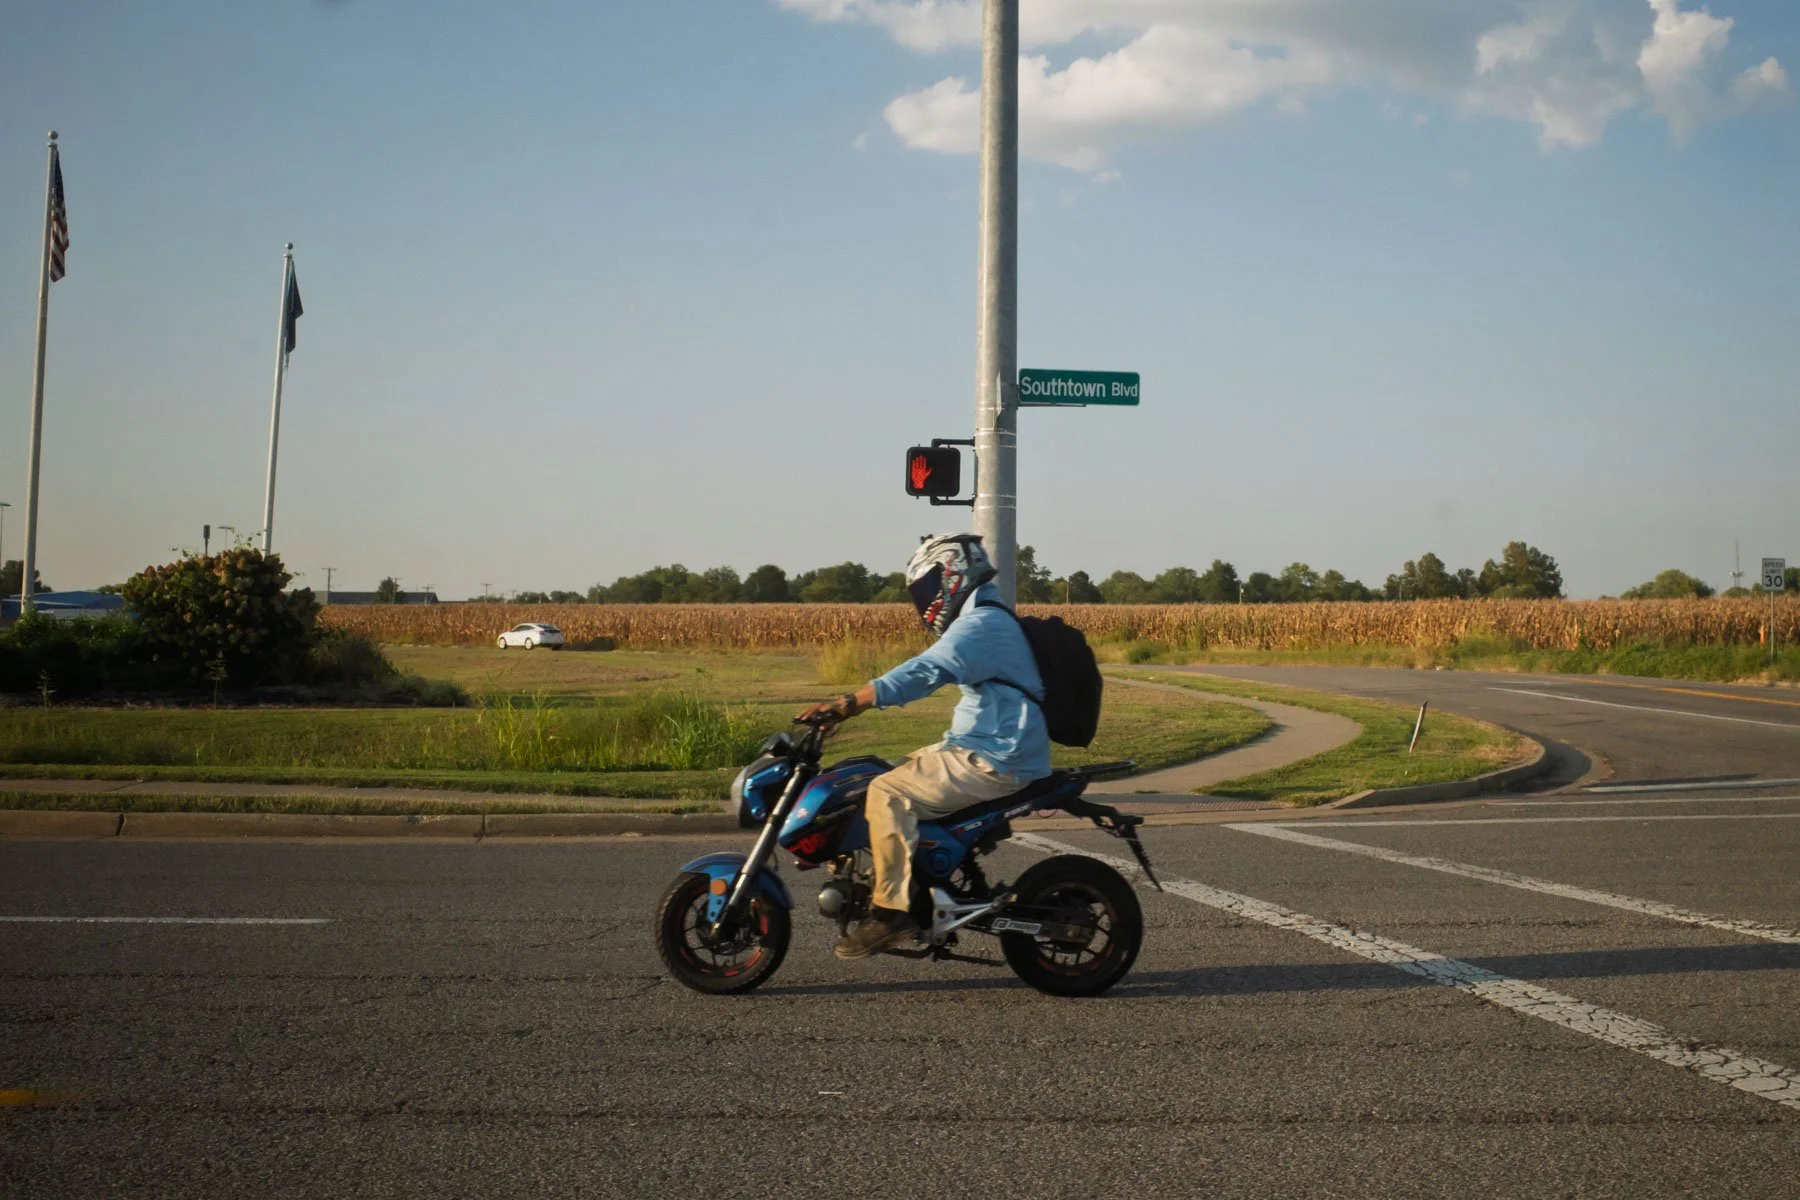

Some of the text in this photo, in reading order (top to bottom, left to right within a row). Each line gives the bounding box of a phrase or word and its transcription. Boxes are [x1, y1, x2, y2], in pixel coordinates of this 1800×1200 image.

[1021, 376, 1138, 398] Southtown Blvd
[1764, 575, 1783, 587] 30
